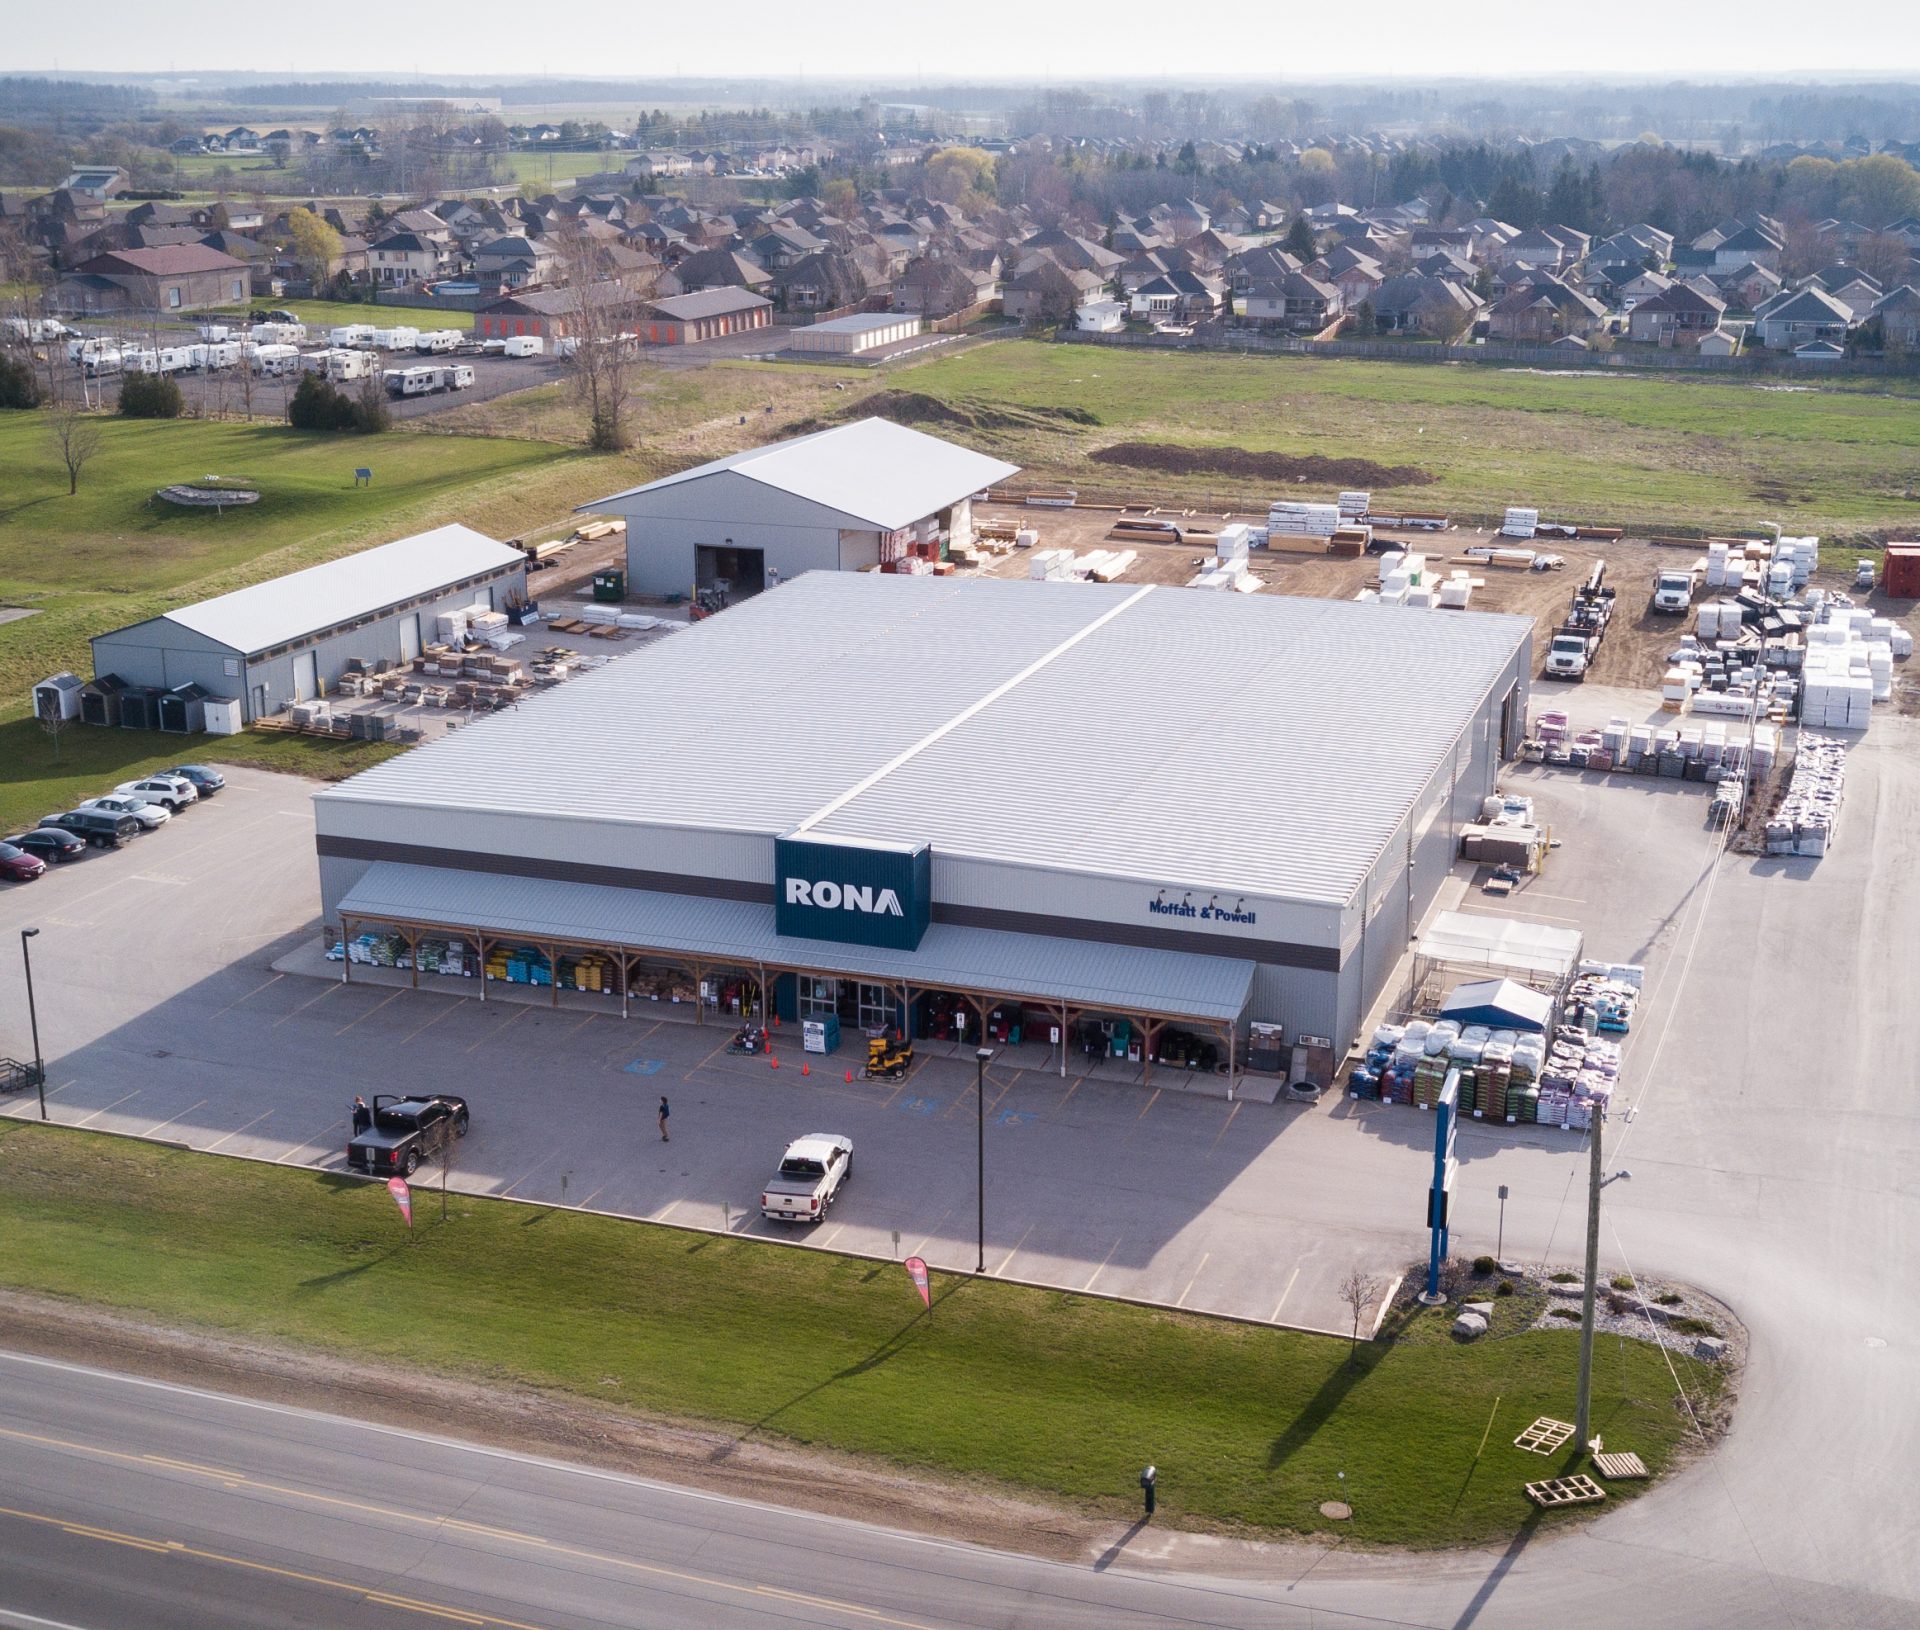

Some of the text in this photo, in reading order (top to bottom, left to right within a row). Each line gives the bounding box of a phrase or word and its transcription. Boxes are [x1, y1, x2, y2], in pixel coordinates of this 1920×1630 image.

[786, 877, 904, 916] RONA
[1149, 901, 1256, 924] Moffatt & Powell
